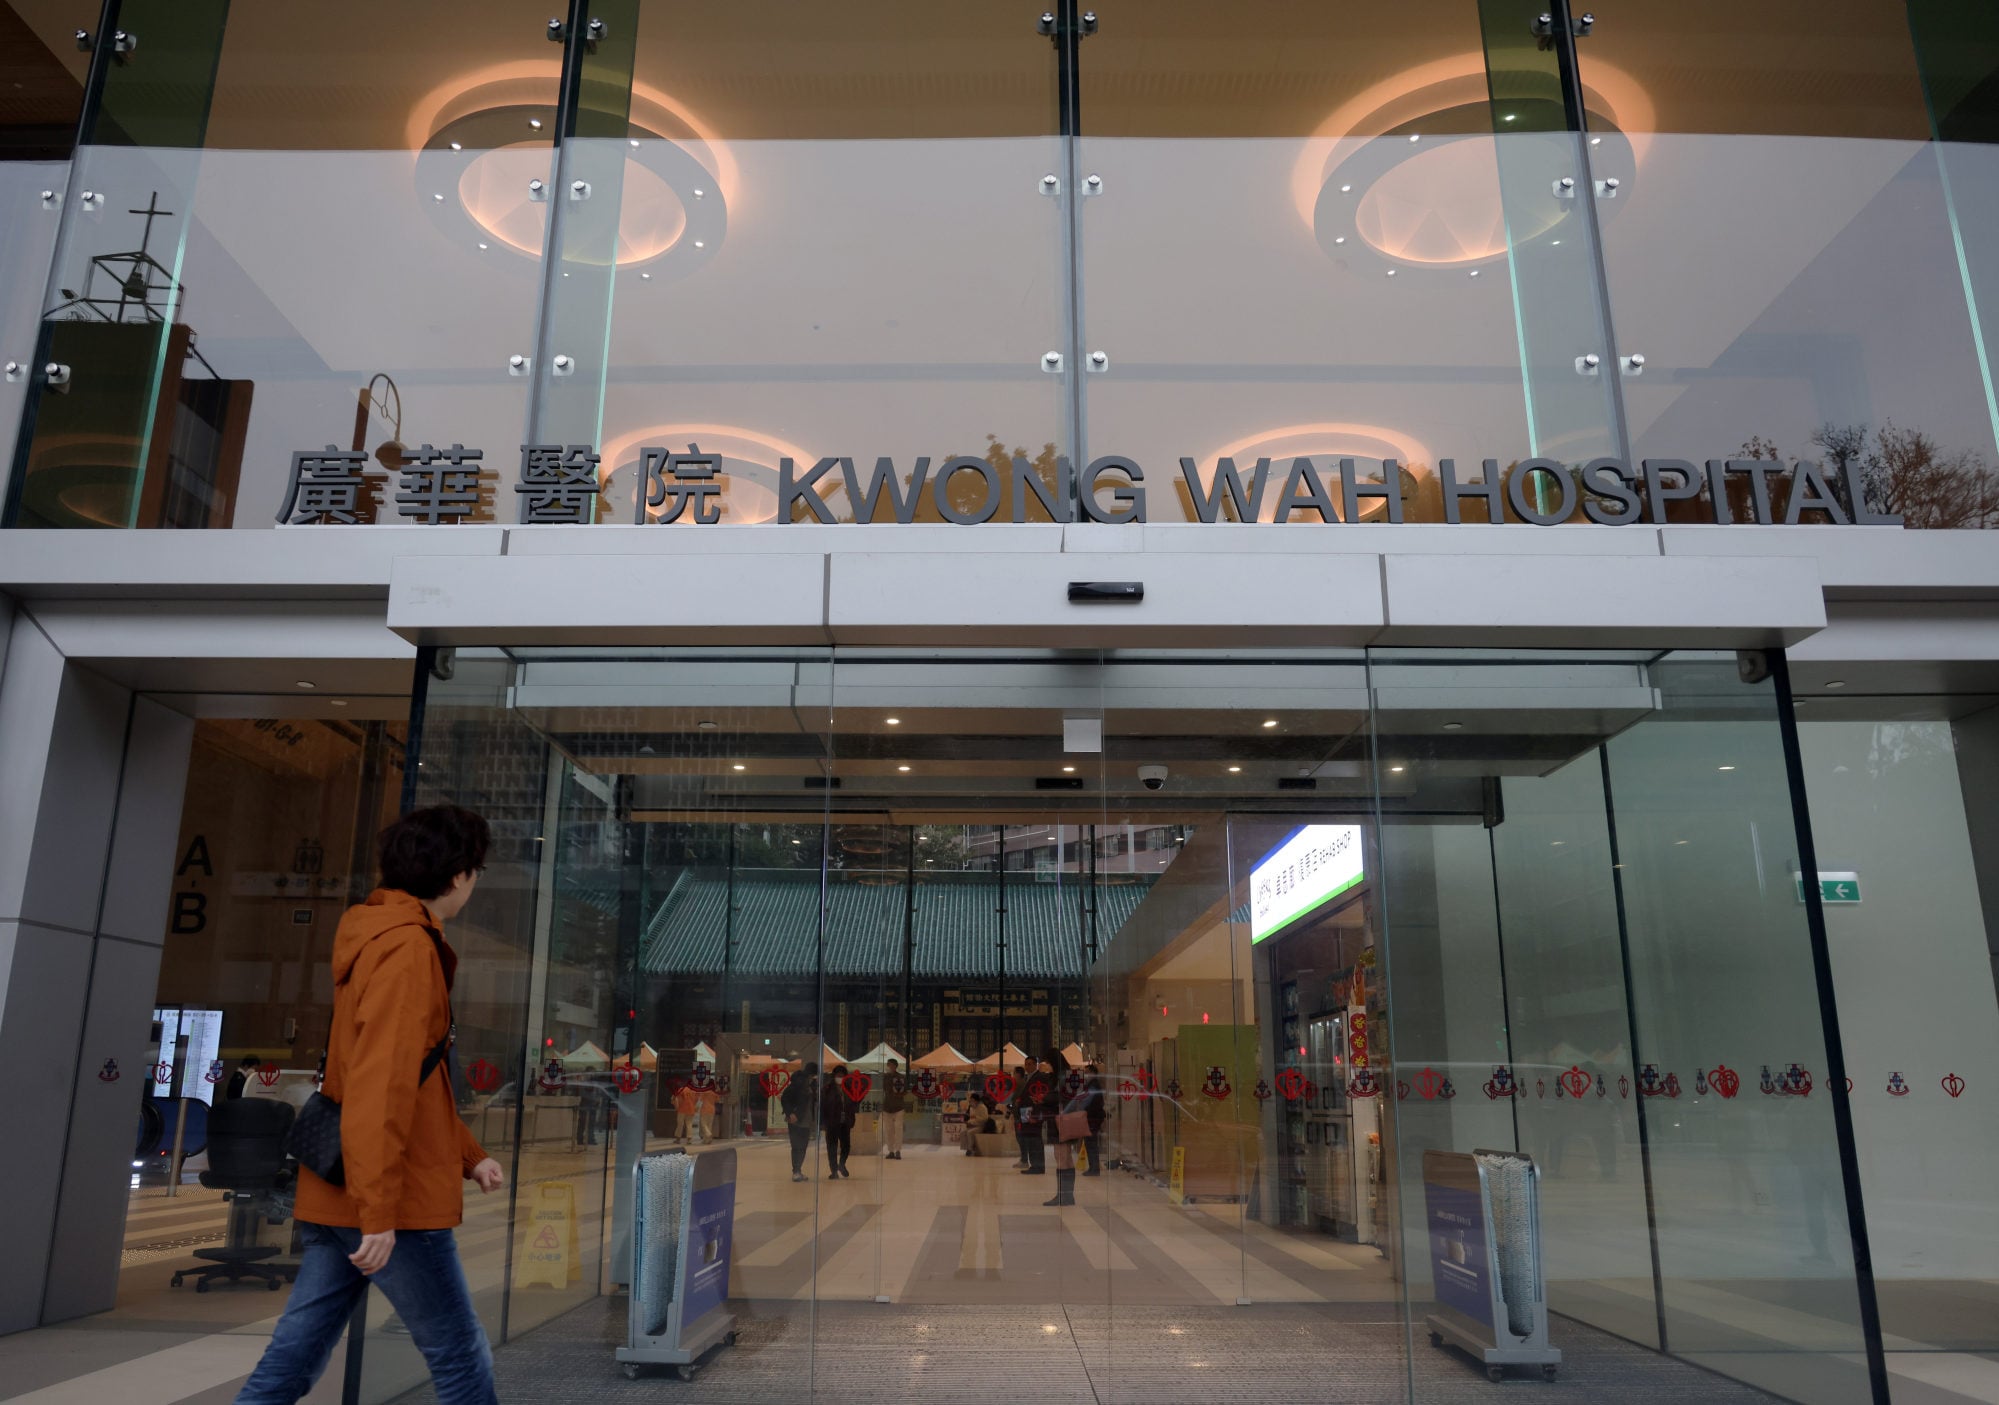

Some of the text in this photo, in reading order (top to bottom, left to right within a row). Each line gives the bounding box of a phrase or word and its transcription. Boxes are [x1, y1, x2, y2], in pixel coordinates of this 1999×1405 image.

[275, 443, 1904, 525] 廣華醫院 KWONG WAH HOSPITAL
[1336, 830, 1352, 855] SHOP
